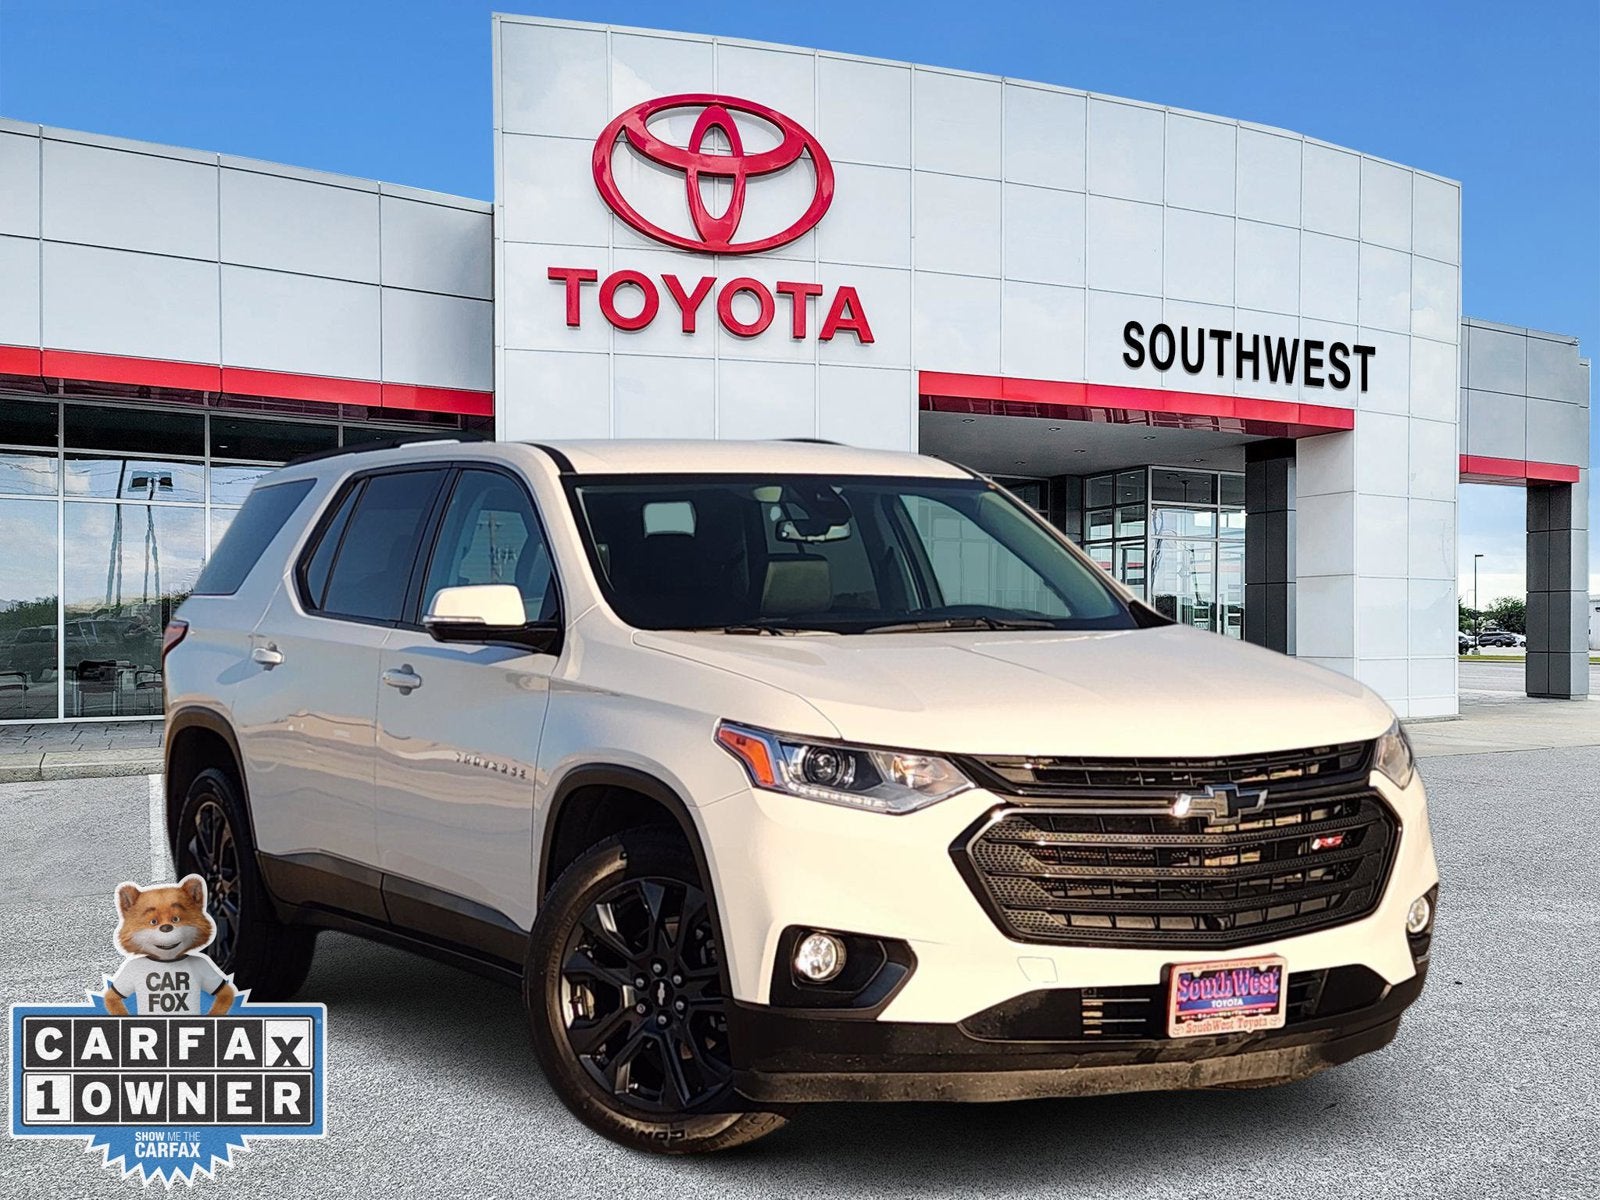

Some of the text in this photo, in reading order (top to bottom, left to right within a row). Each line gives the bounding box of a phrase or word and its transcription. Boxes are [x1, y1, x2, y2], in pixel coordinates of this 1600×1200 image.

[547, 266, 875, 344] TOYOTA
[1123, 320, 1376, 393] SOUTHWEST
[1211, 998, 1244, 1008] TOYOTA
[1237, 1018, 1268, 1031] Toyota
